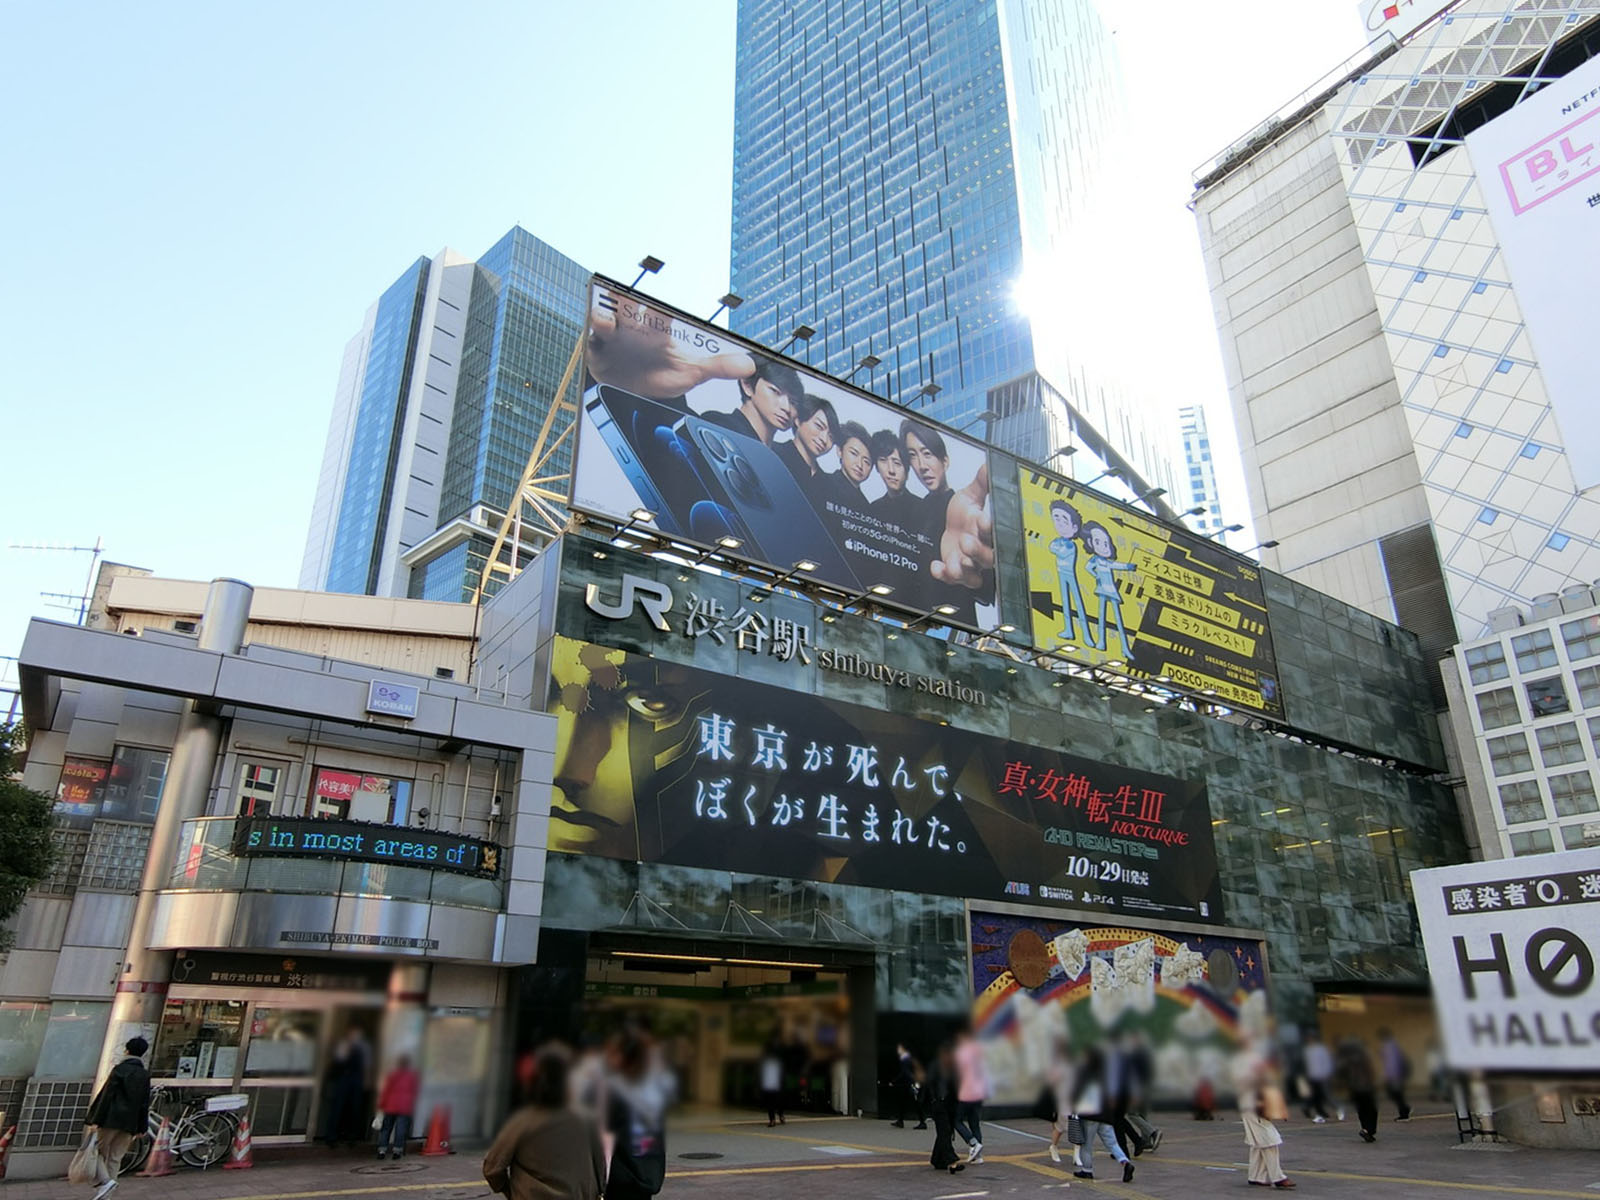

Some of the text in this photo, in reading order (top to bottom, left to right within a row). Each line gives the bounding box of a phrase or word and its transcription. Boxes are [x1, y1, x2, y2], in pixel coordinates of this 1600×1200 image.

[1562, 86, 1600, 115] NETF
[622, 303, 690, 343] SoftBank
[693, 333, 720, 354] 5G
[854, 541, 918, 571] iPhone 12 Pro
[1142, 556, 1203, 589] ディスコ仕様
[585, 573, 987, 706] JR 渋谷駅 shibuya station
[1168, 667, 1202, 687] DOSCO
[696, 713, 963, 802] 東京が死んで、
[695, 777, 967, 853] ぼくが生まれた。
[271, 826, 295, 848] in
[303, 829, 364, 853] most
[374, 836, 438, 861] areas
[446, 844, 466, 866] of
[1110, 820, 1190, 847] NOCTURNE
[1065, 855, 1150, 886] 10月29日発売
[1004, 881, 1030, 896] ATLUS
[379, 936, 411, 948] POLICE
[416, 940, 435, 949] BOX
